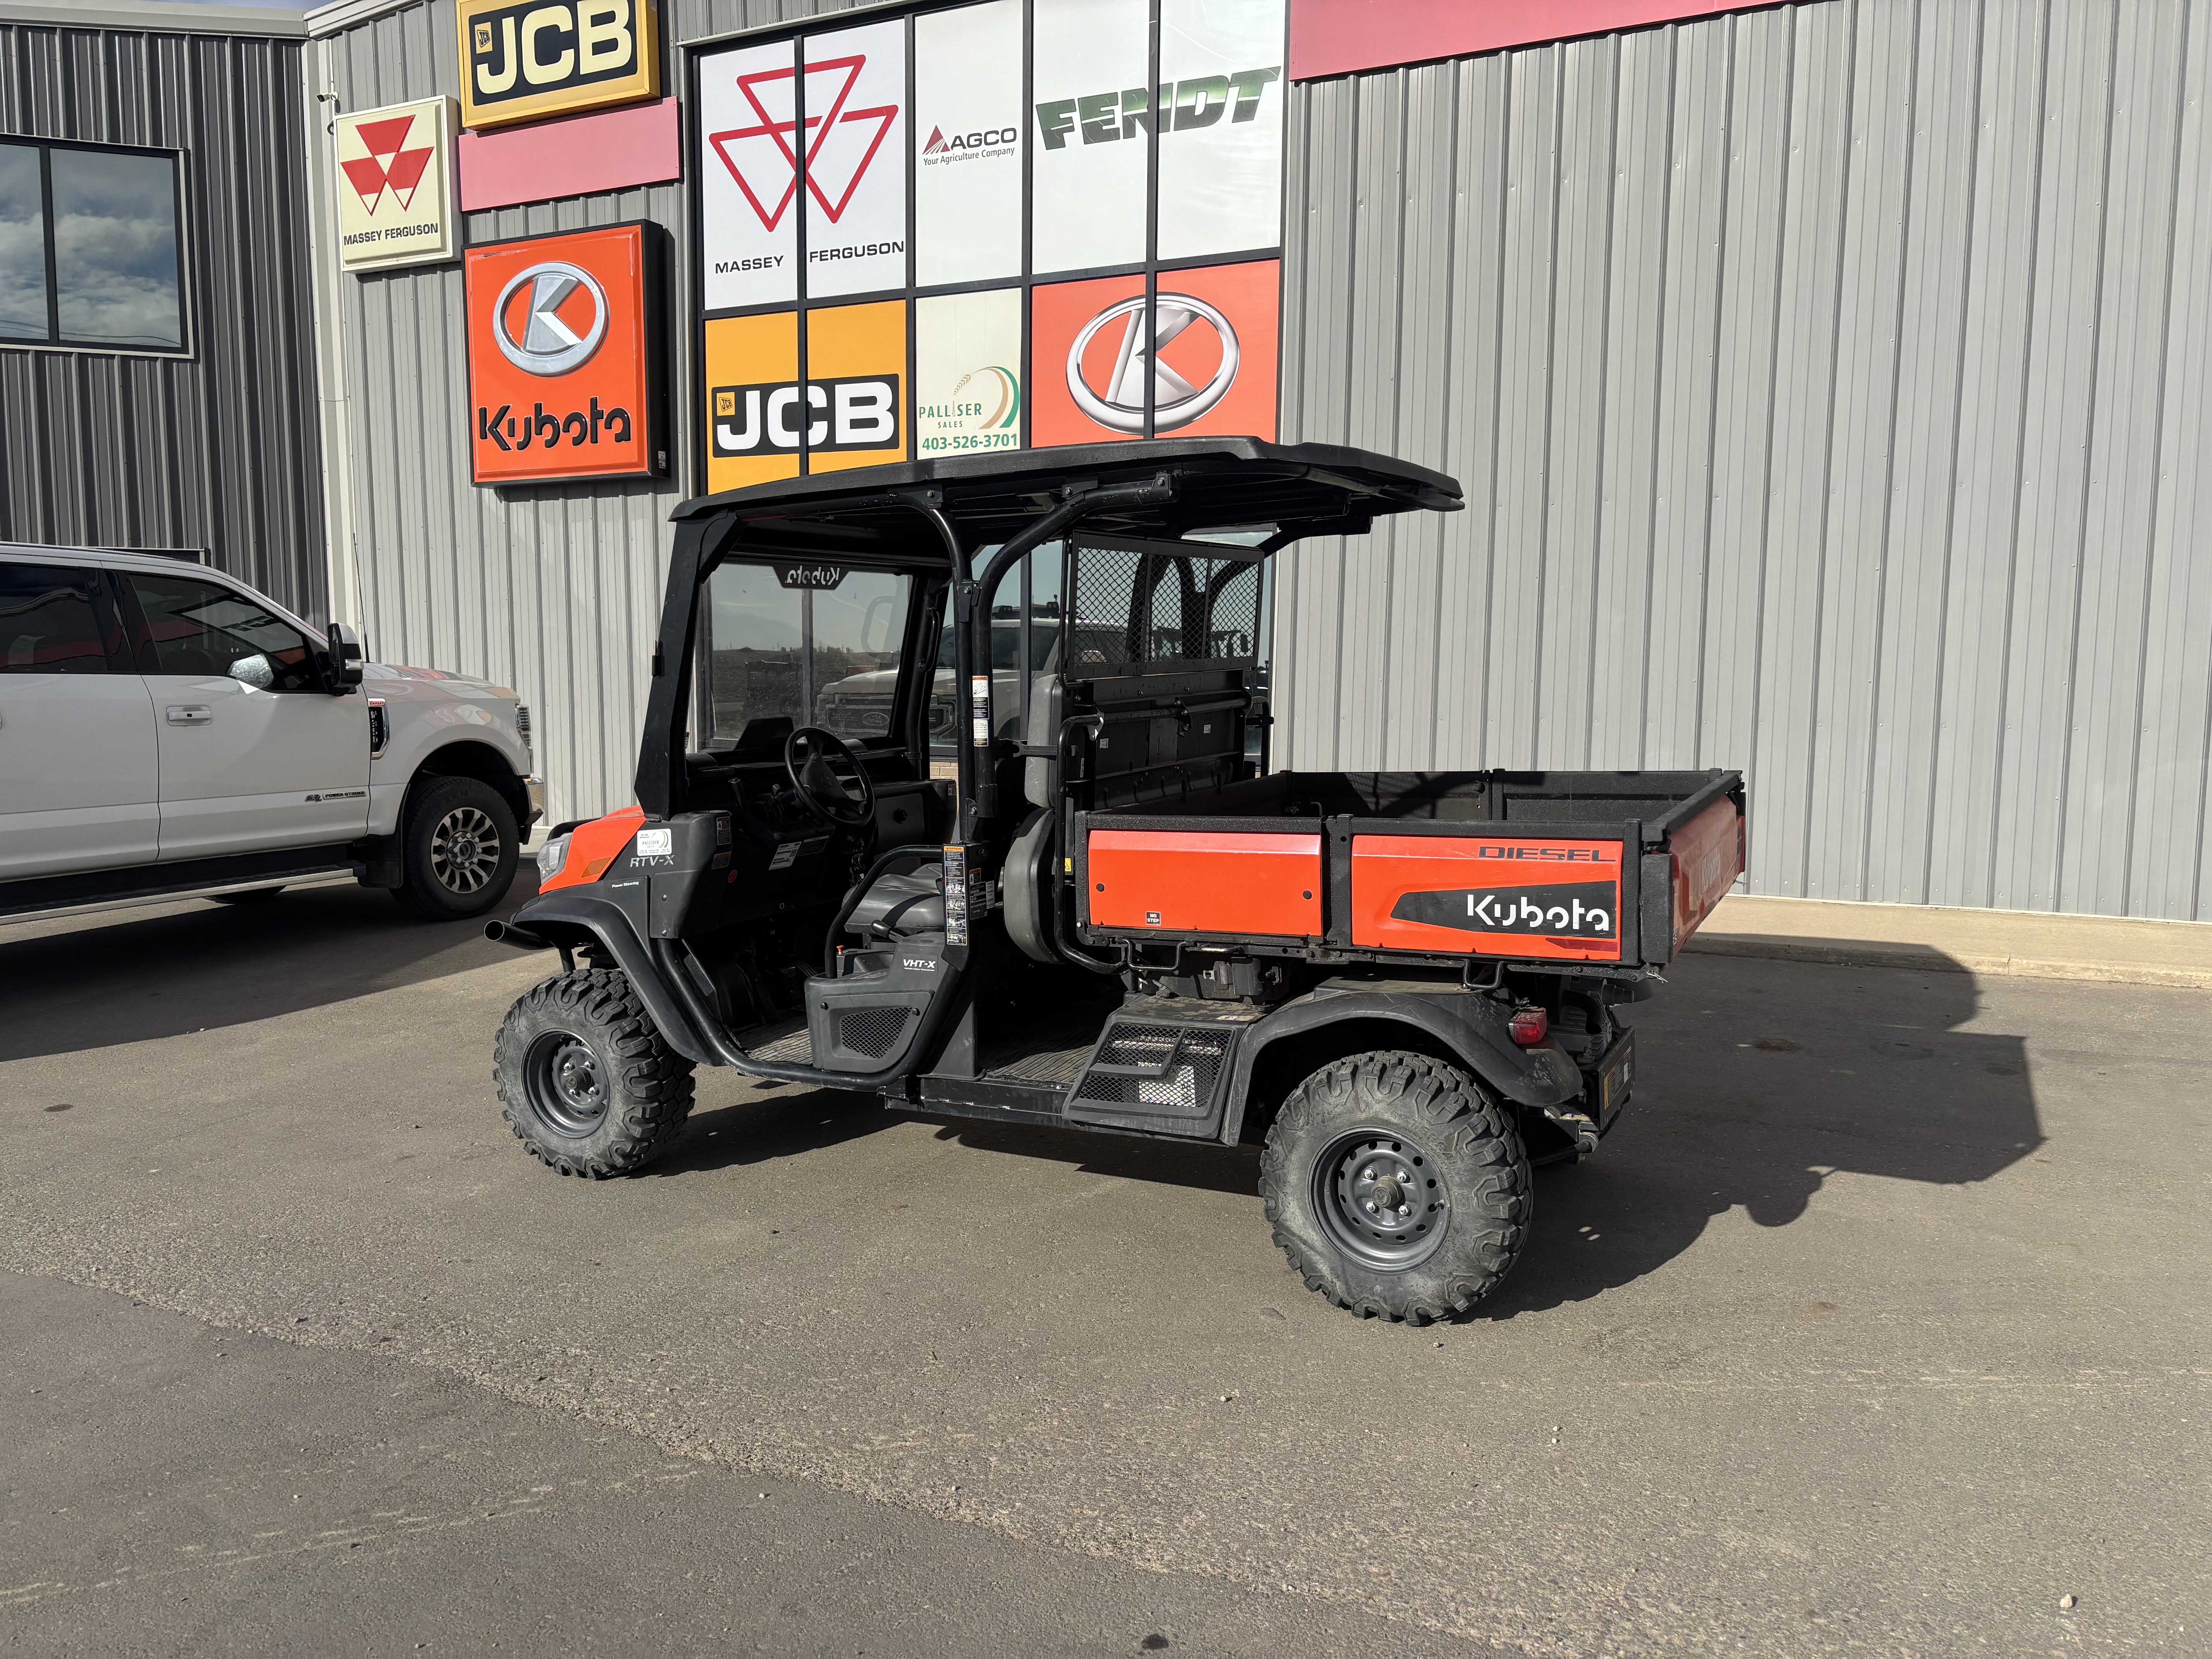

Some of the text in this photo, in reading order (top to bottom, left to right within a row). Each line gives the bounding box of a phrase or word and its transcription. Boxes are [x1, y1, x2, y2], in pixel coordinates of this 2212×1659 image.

[477, 0, 632, 94] JCB
[479, 31, 490, 45] JCB
[1036, 66, 1281, 150] FENDT
[950, 127, 1017, 150] AGCO
[923, 148, 1015, 166] Your Agriculture Company
[343, 222, 439, 246] MASSEY FERGUSON
[715, 241, 905, 274] MASSEY FERGUSON
[717, 381, 895, 450] JCB
[721, 399, 732, 410] JCB
[478, 397, 632, 451] Kubota
[922, 433, 1017, 450] 403-526-3701
[630, 855, 675, 867] RTV-X
[1479, 846, 1616, 862] DIESEL
[1467, 894, 1609, 931] Kubota
[903, 959, 936, 968] VHT-X
